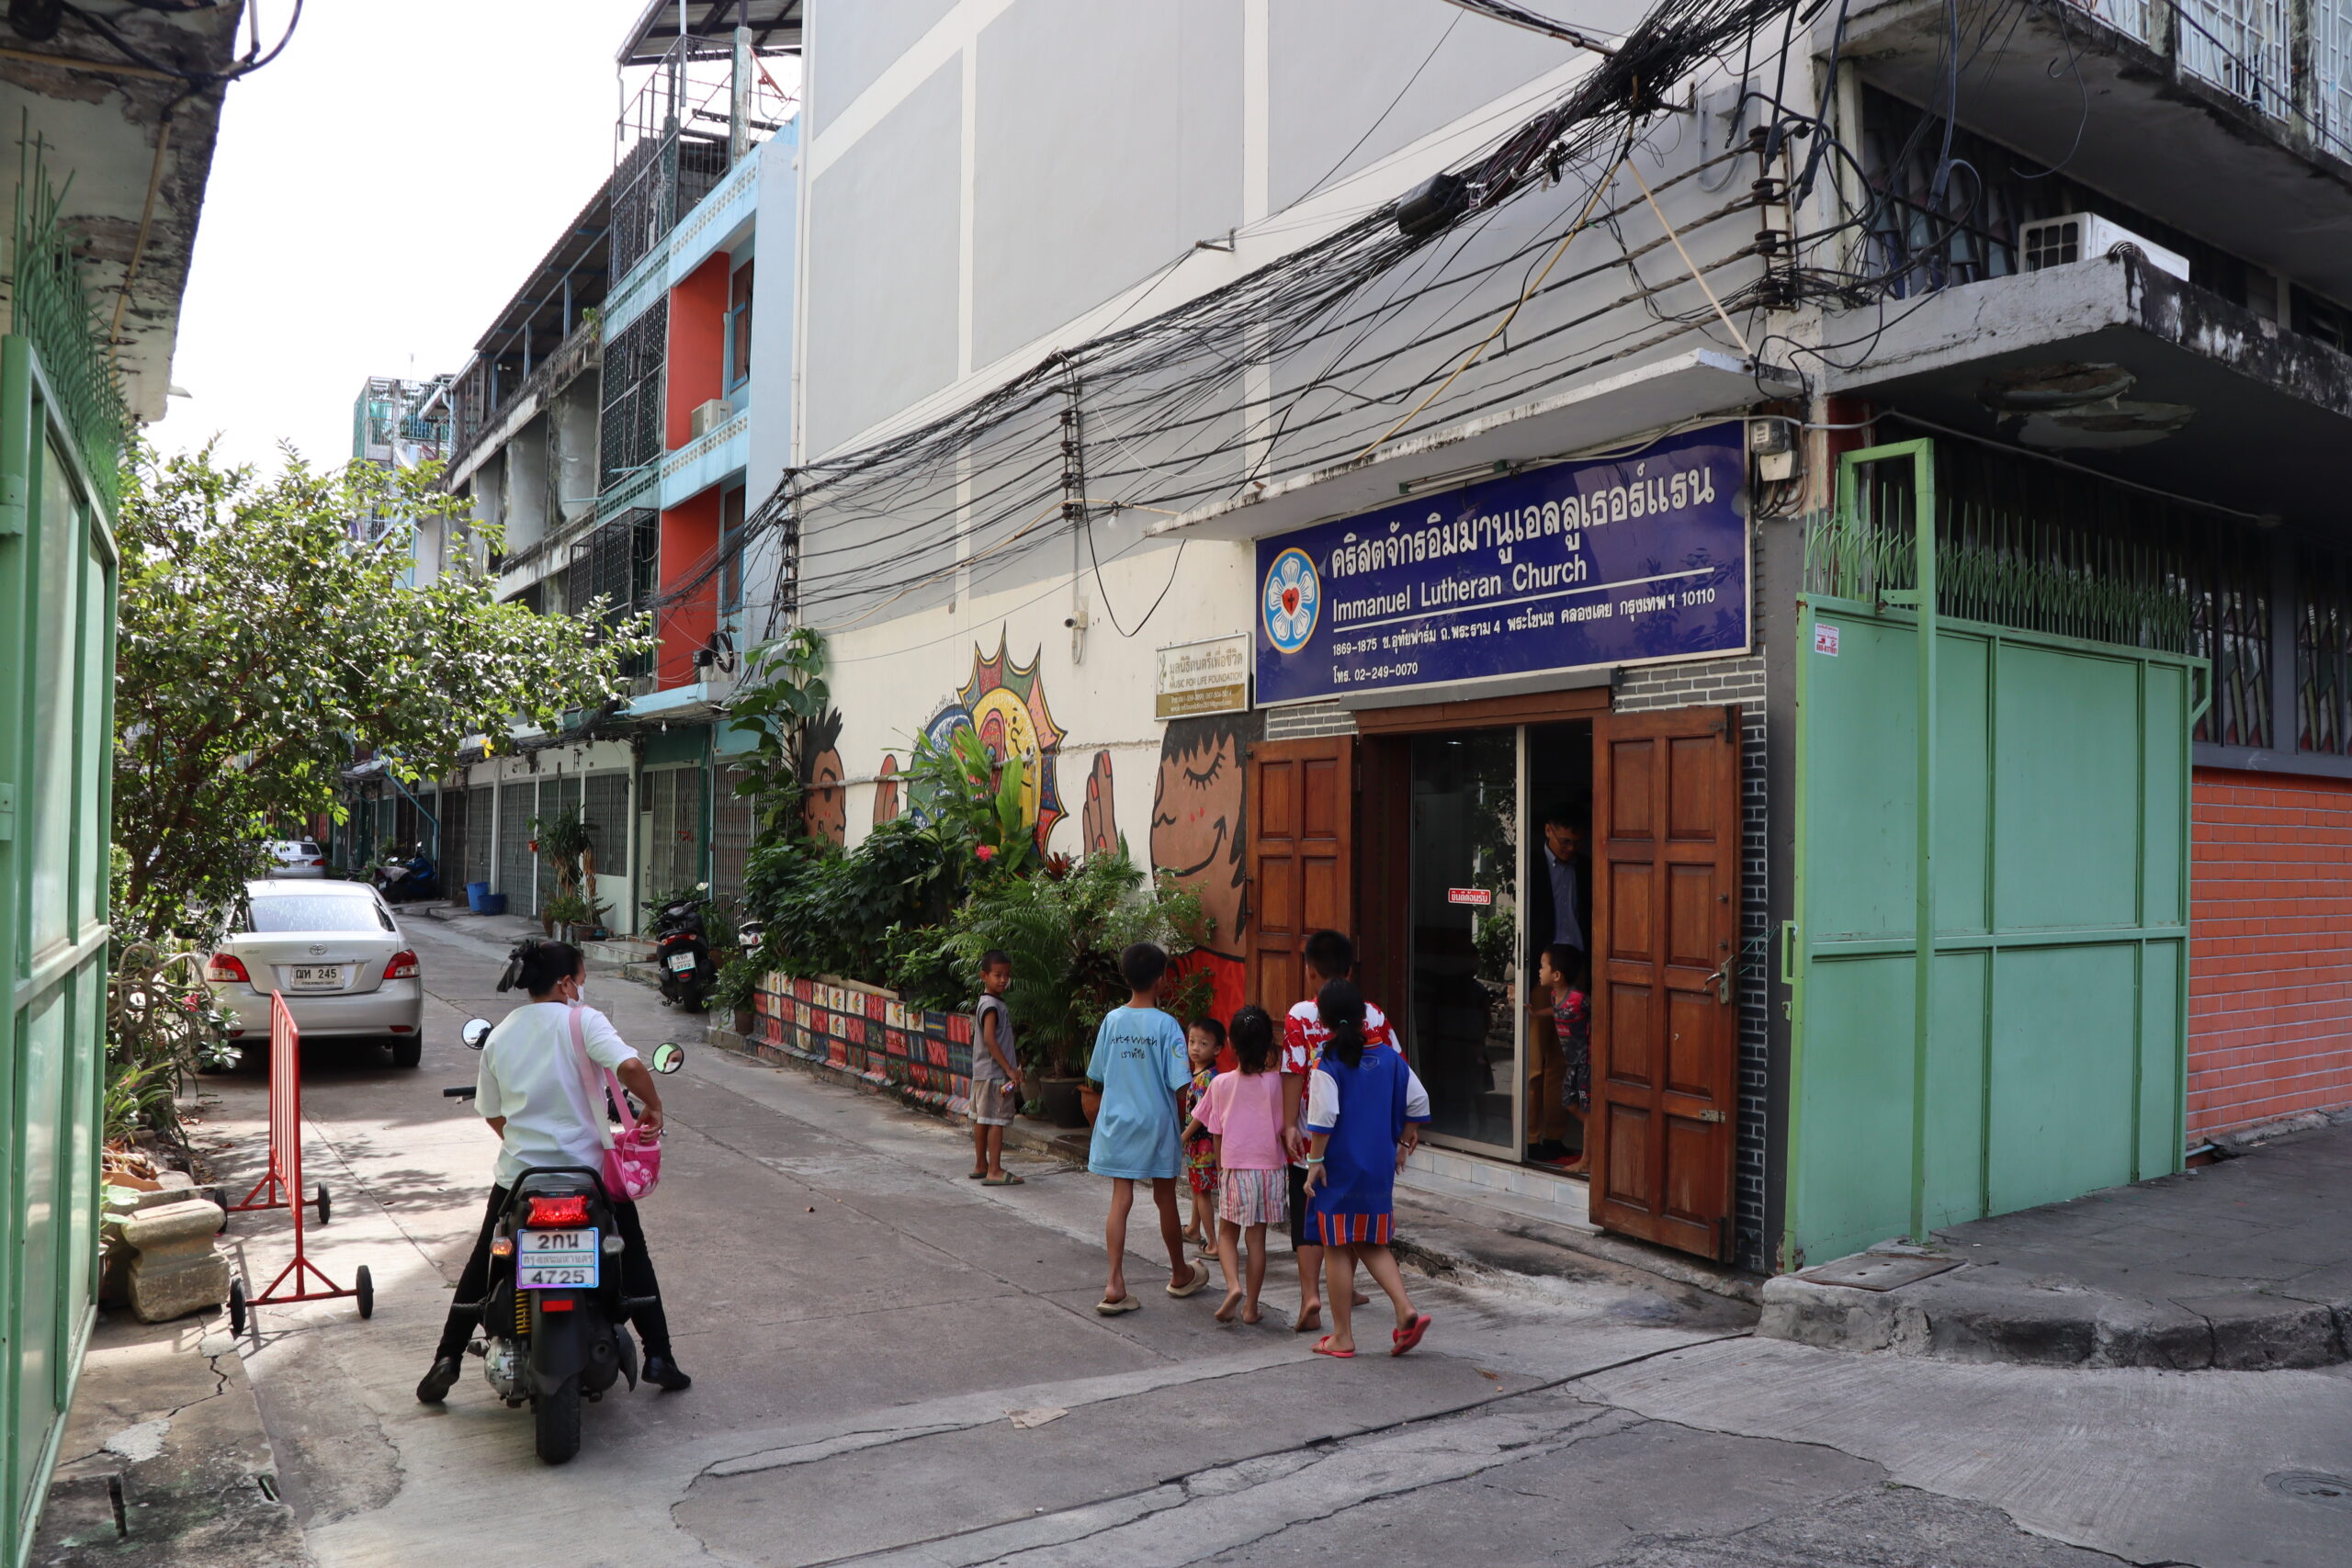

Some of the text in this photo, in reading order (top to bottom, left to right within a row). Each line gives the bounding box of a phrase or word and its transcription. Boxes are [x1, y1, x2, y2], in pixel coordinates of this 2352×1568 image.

[1332, 462, 1715, 579] คริสตจักรอิมมานูเอลลูเธอร์แรน
[1333, 554, 1587, 622] Immanuel Lutheran Church
[1333, 639, 1377, 656] 1869-1875
[1493, 620, 1500, 634] 4
[1507, 607, 1555, 632] พระโขนง
[1561, 603, 1612, 624] คลองเตย
[1681, 587, 1715, 607] 10110
[1170, 671, 1243, 690] MUSIC FOR LIFE FOUNDATION
[1333, 662, 1419, 683] โทร. 02-249-0070
[1451, 890, 1488, 903] ยินดีต้อนรับ
[318, 968, 337, 979] 245
[537, 1233, 579, 1250] 2กน
[531, 1269, 585, 1284] 4725
